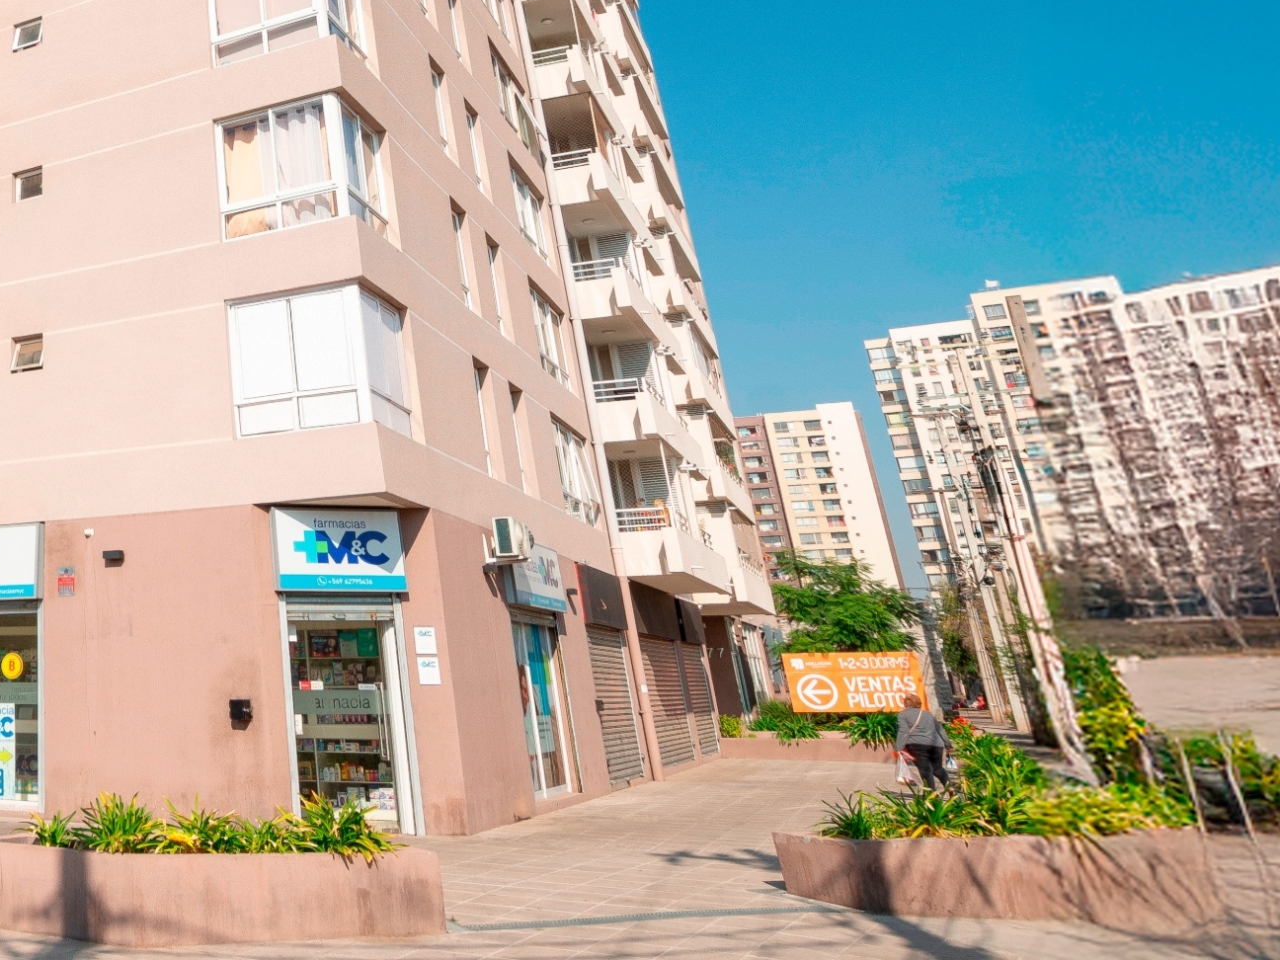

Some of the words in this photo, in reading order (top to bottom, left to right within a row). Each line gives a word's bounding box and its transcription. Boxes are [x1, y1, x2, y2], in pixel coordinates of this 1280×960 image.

[313, 518, 366, 528] farmacias
[315, 530, 390, 566] M&C
[870, 656, 910, 669] DORMS
[843, 675, 917, 692] VENTAS
[847, 691, 918, 709] PILOTO
